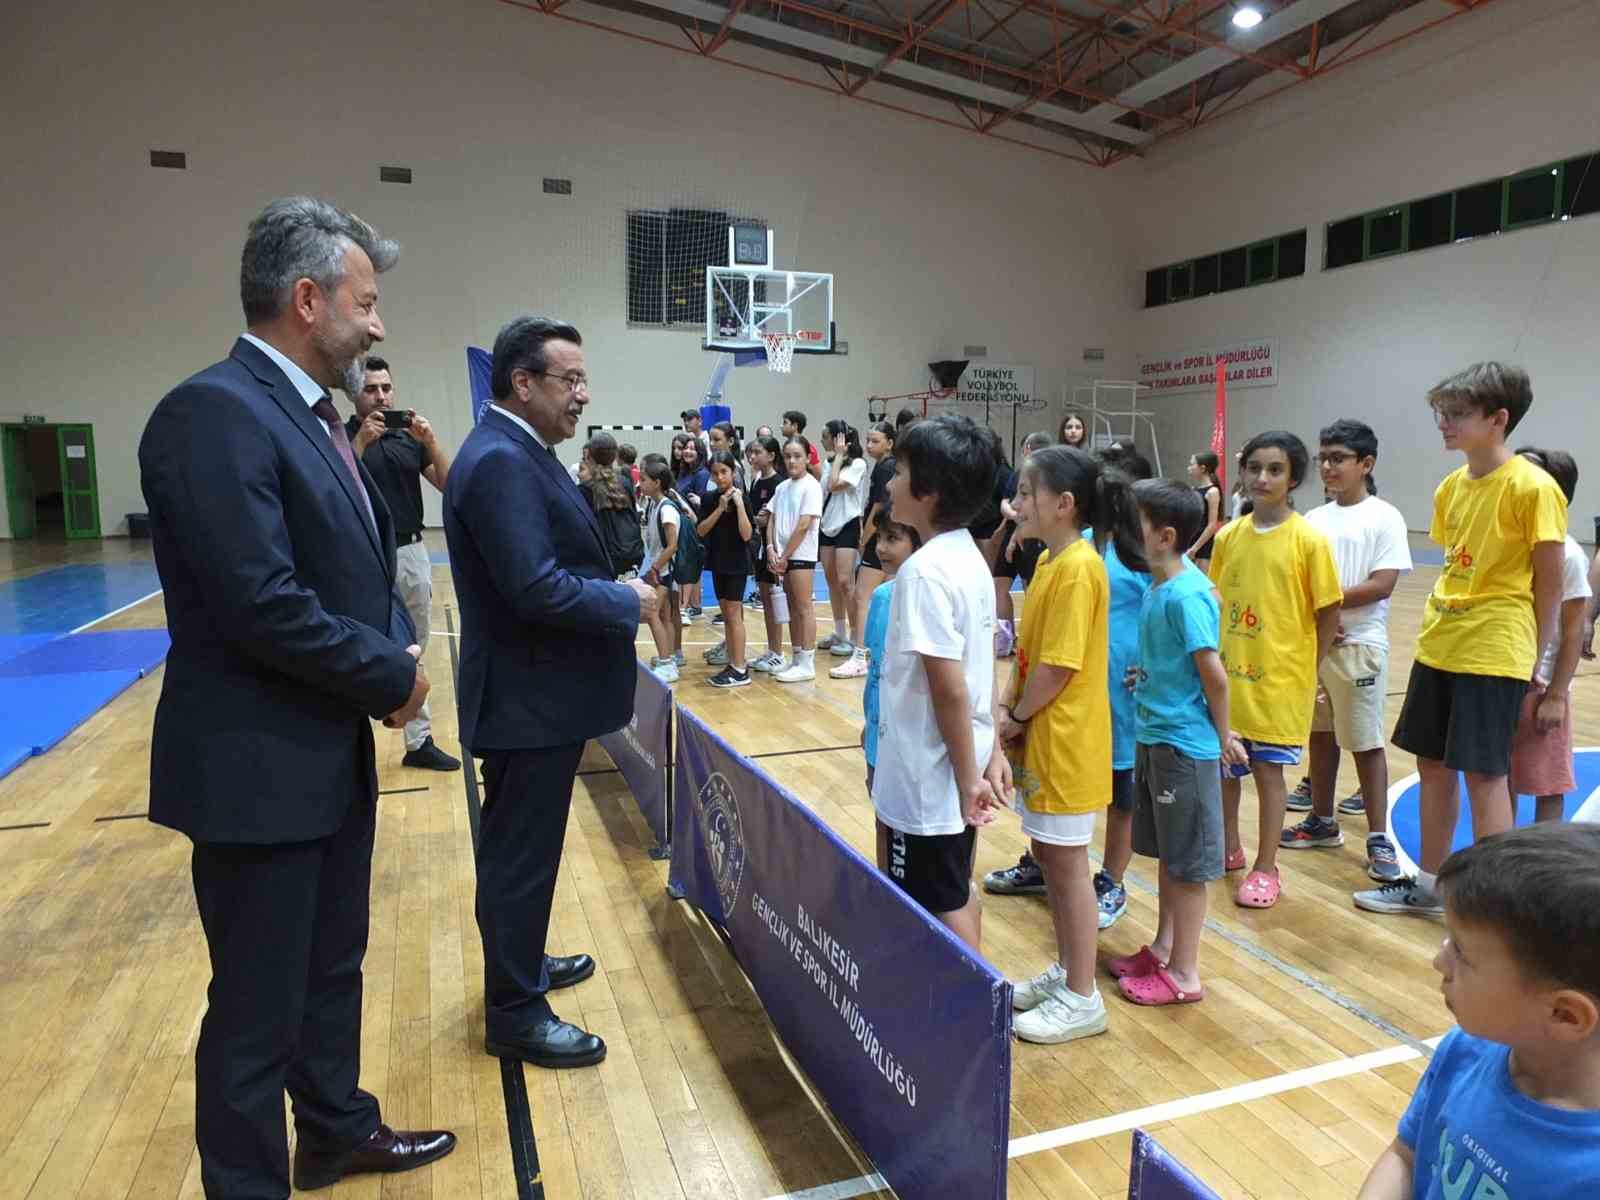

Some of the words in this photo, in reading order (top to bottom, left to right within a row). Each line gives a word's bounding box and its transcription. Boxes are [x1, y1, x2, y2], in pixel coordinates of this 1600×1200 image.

[1183, 355, 1204, 369] SPOR
[1246, 366, 1272, 380] DİLER
[798, 903, 860, 992] BALIKESİR
[752, 892, 789, 947] GENÇLİK
[790, 931, 803, 961] VE
[802, 950, 828, 994] SPOR
[829, 975, 839, 1009] İL
[840, 995, 916, 1107] MÜDÜRLÜĞÜ
[1462, 1133, 1510, 1183] ORIGINAL
